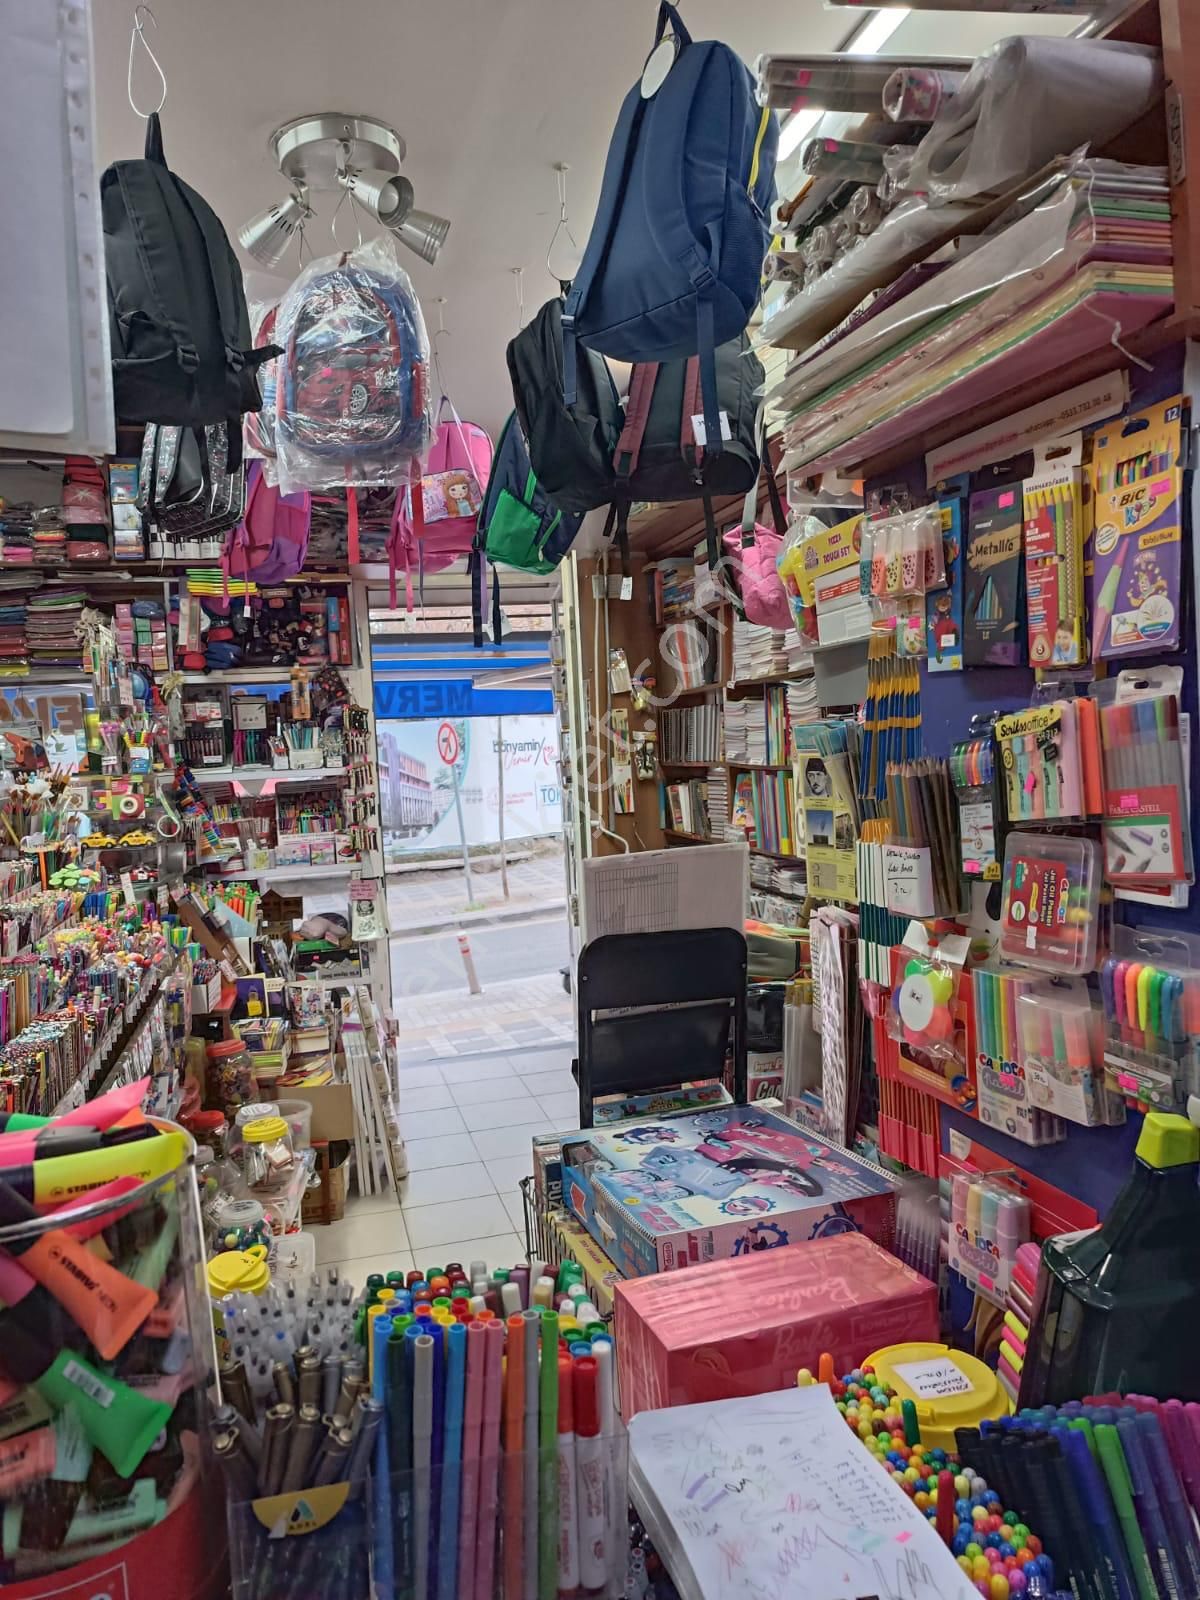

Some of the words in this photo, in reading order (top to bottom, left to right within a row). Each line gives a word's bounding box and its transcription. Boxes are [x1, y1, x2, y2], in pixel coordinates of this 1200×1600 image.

[1166, 406, 1179, 421] 12
[1119, 487, 1146, 507] BIC
[974, 533, 1014, 559] Metallic
[1045, 899, 1056, 928] Pastel
[978, 1053, 1026, 1081] CARIOCA
[956, 1223, 1000, 1260] CARIOCA
